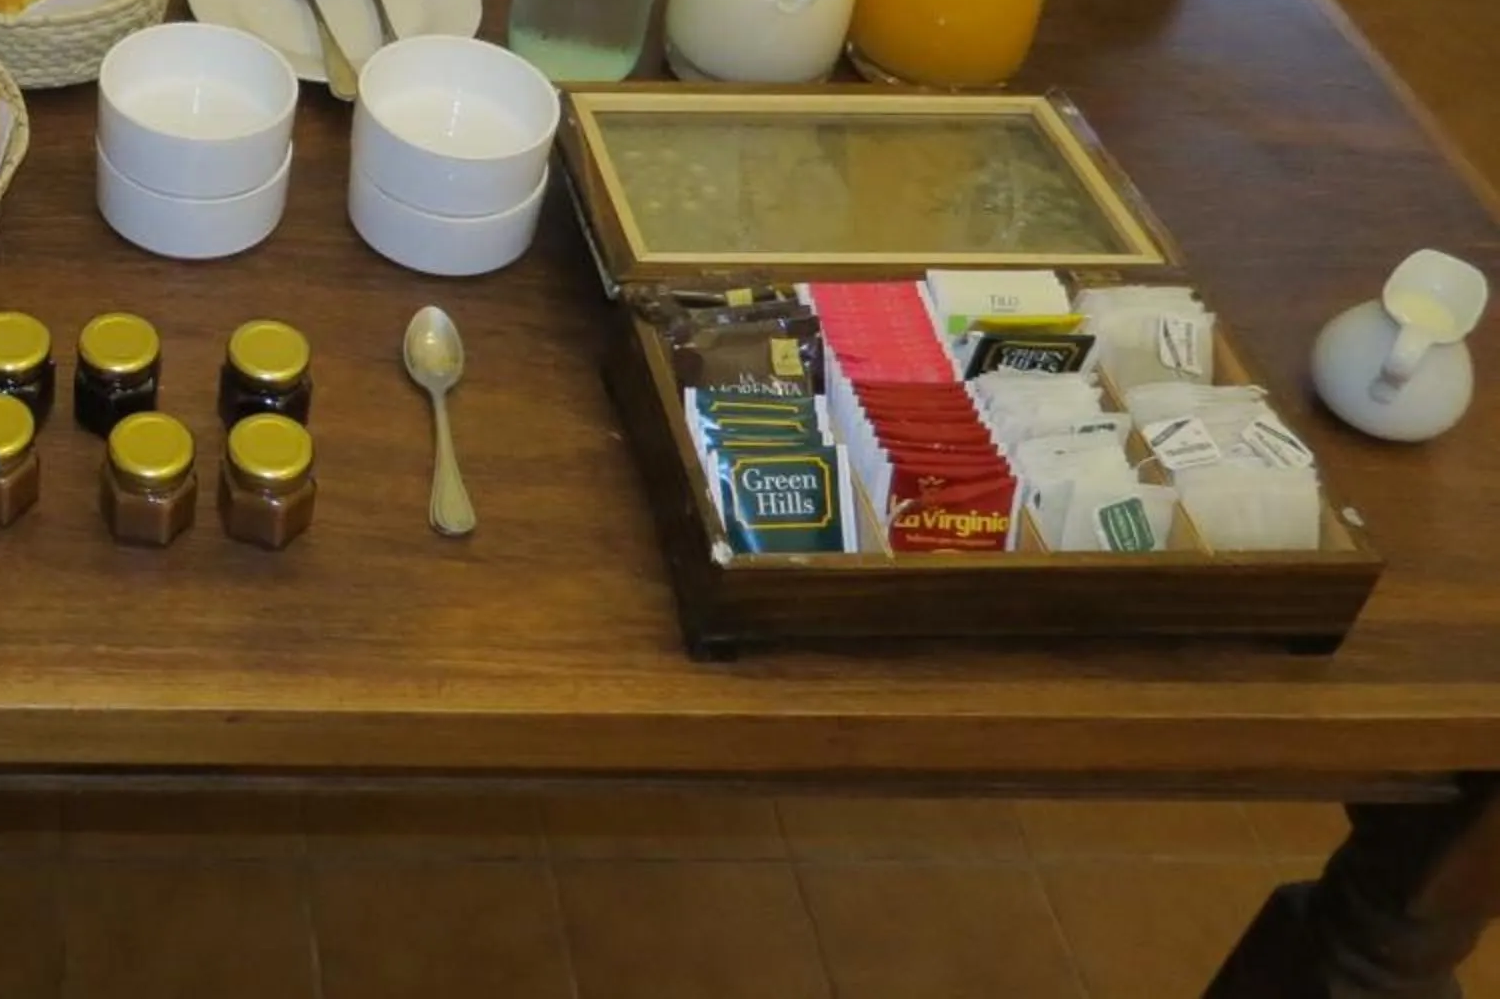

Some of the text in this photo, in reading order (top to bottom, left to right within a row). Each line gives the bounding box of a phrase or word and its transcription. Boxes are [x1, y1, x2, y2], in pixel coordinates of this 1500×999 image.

[742, 468, 818, 492] Green
[756, 491, 816, 516] Hills
[894, 511, 920, 528] La
